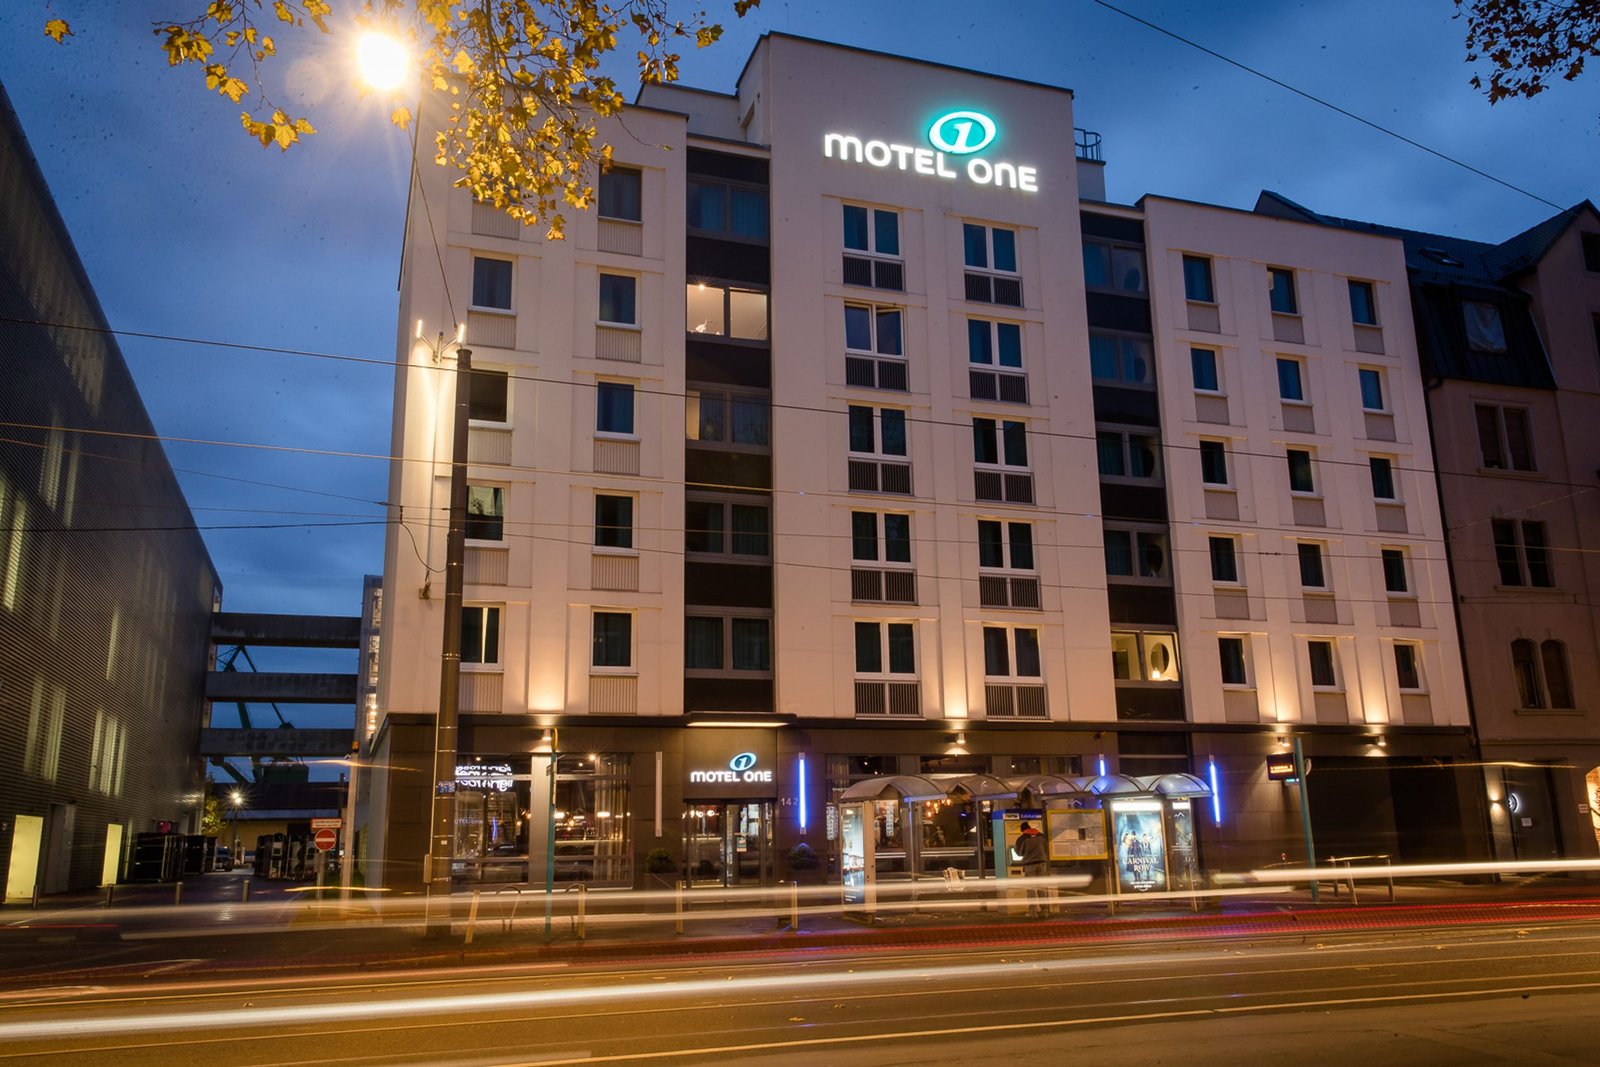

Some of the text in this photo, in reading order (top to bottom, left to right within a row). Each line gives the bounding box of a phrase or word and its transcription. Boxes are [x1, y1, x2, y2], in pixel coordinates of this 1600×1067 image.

[824, 132, 1039, 192] MOTEL ONE
[690, 771, 772, 783] MOTEL ONE
[1123, 856, 1160, 865] CARNIVAL
[1133, 863, 1151, 873] ROW
